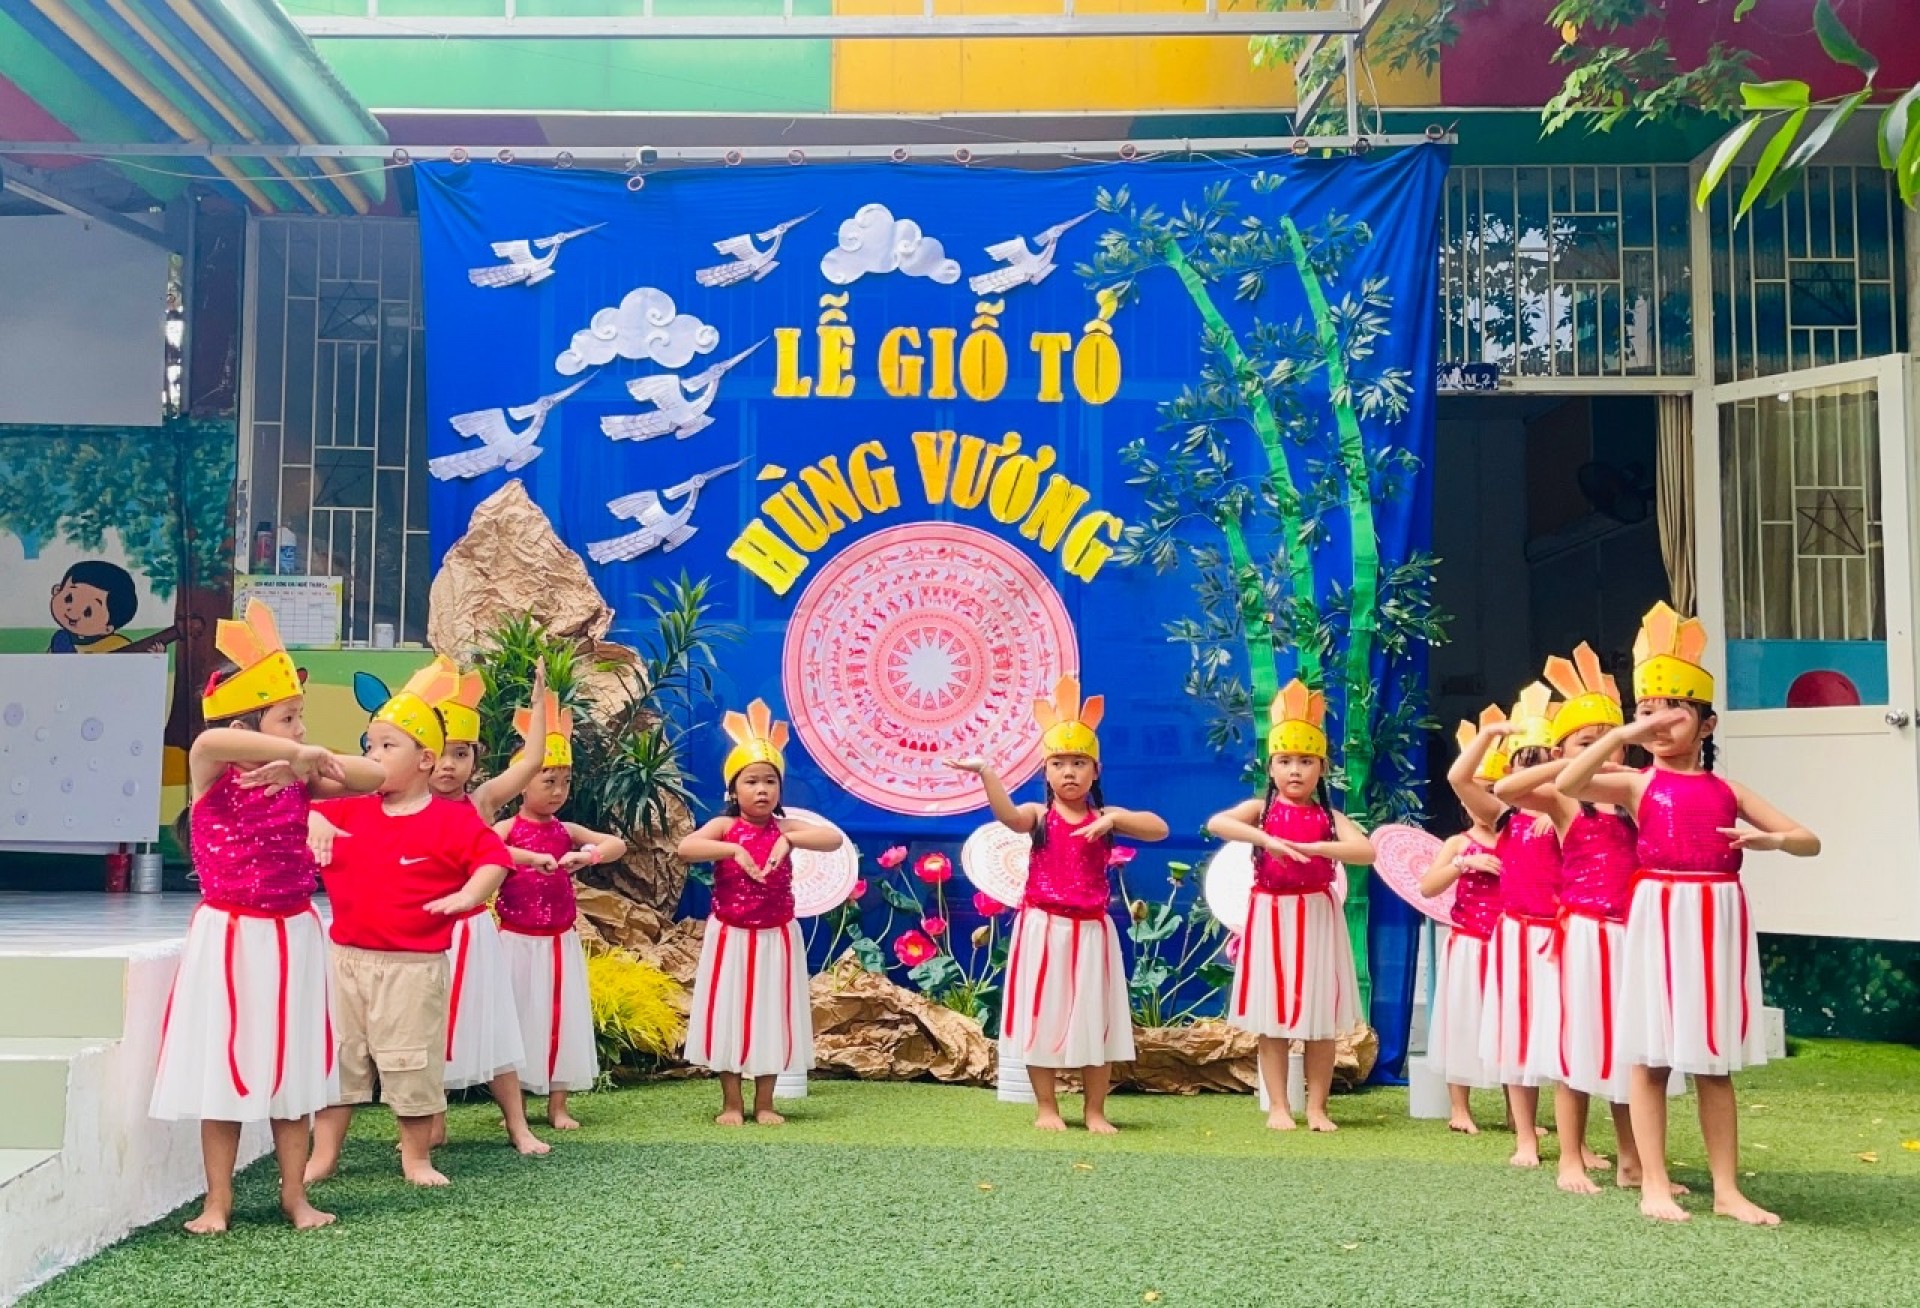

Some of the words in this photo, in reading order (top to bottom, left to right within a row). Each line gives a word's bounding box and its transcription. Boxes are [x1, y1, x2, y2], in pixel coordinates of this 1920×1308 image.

[773, 291, 855, 398] LỄ
[878, 299, 1008, 401] GIỖ
[1031, 290, 1121, 404] TỔ
[726, 441, 900, 595] HÙNG
[911, 430, 1124, 582] VƯƠNG
